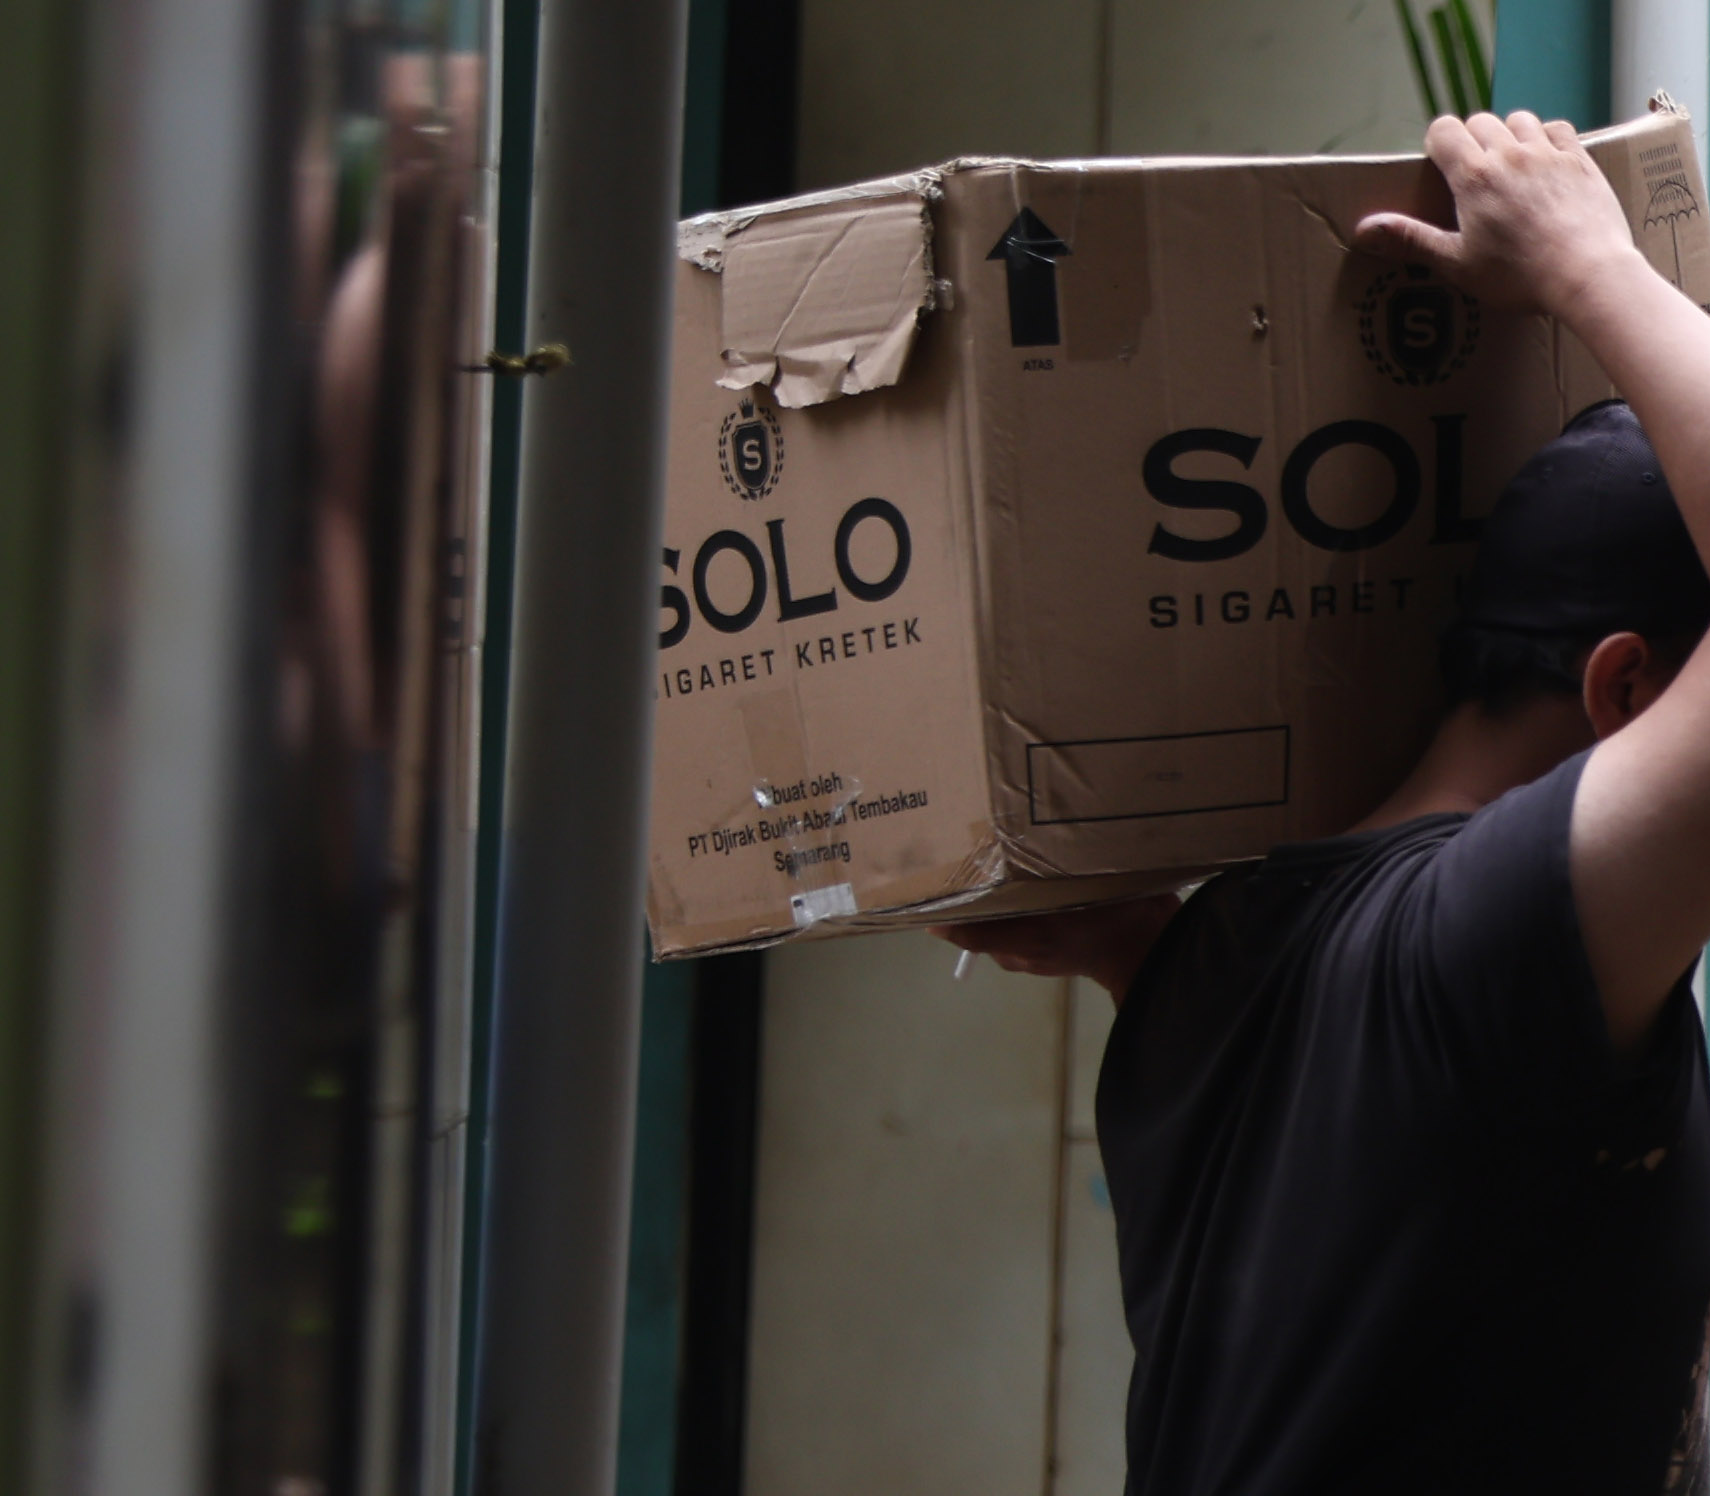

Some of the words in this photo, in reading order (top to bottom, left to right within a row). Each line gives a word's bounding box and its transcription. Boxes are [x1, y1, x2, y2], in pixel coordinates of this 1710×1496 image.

[1403, 308, 1437, 348] S
[1022, 359, 1054, 371] ATAS
[742, 439, 762, 471] S
[1142, 413, 1489, 562] SOL
[1149, 578, 1414, 628] SIGARET
[663, 649, 775, 698] IGARET
[796, 617, 921, 668] KRETEK
[755, 782, 807, 809] buat
[811, 772, 842, 797] oleh
[688, 834, 708, 856] PT
[712, 822, 756, 855] Djirak
[848, 790, 928, 822] Tembakau
[774, 840, 851, 872] Semarang
